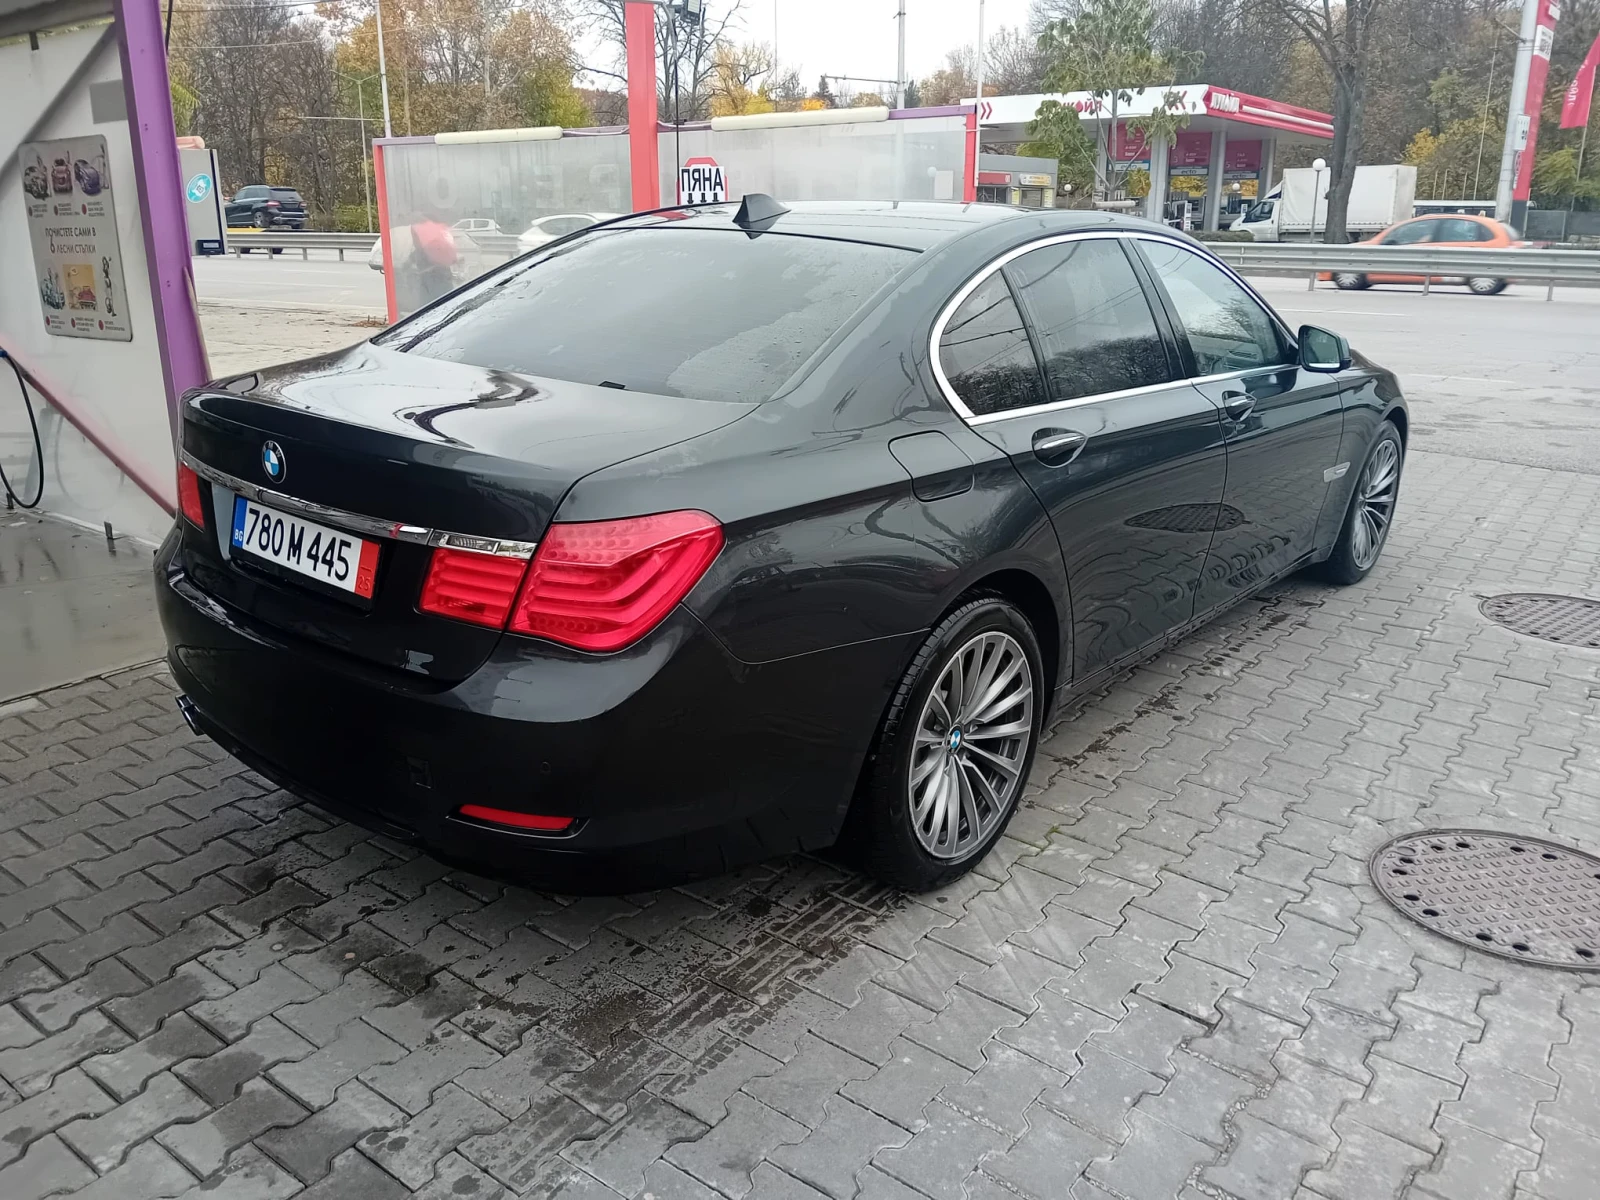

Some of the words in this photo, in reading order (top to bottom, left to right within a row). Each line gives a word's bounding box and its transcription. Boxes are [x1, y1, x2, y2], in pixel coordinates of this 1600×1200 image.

[681, 168, 724, 192] ПЯНА
[74, 227, 91, 237] САМИ
[234, 528, 244, 542] BG
[246, 508, 284, 556] 780
[306, 531, 352, 582] 445
[358, 574, 371, 592] 25
